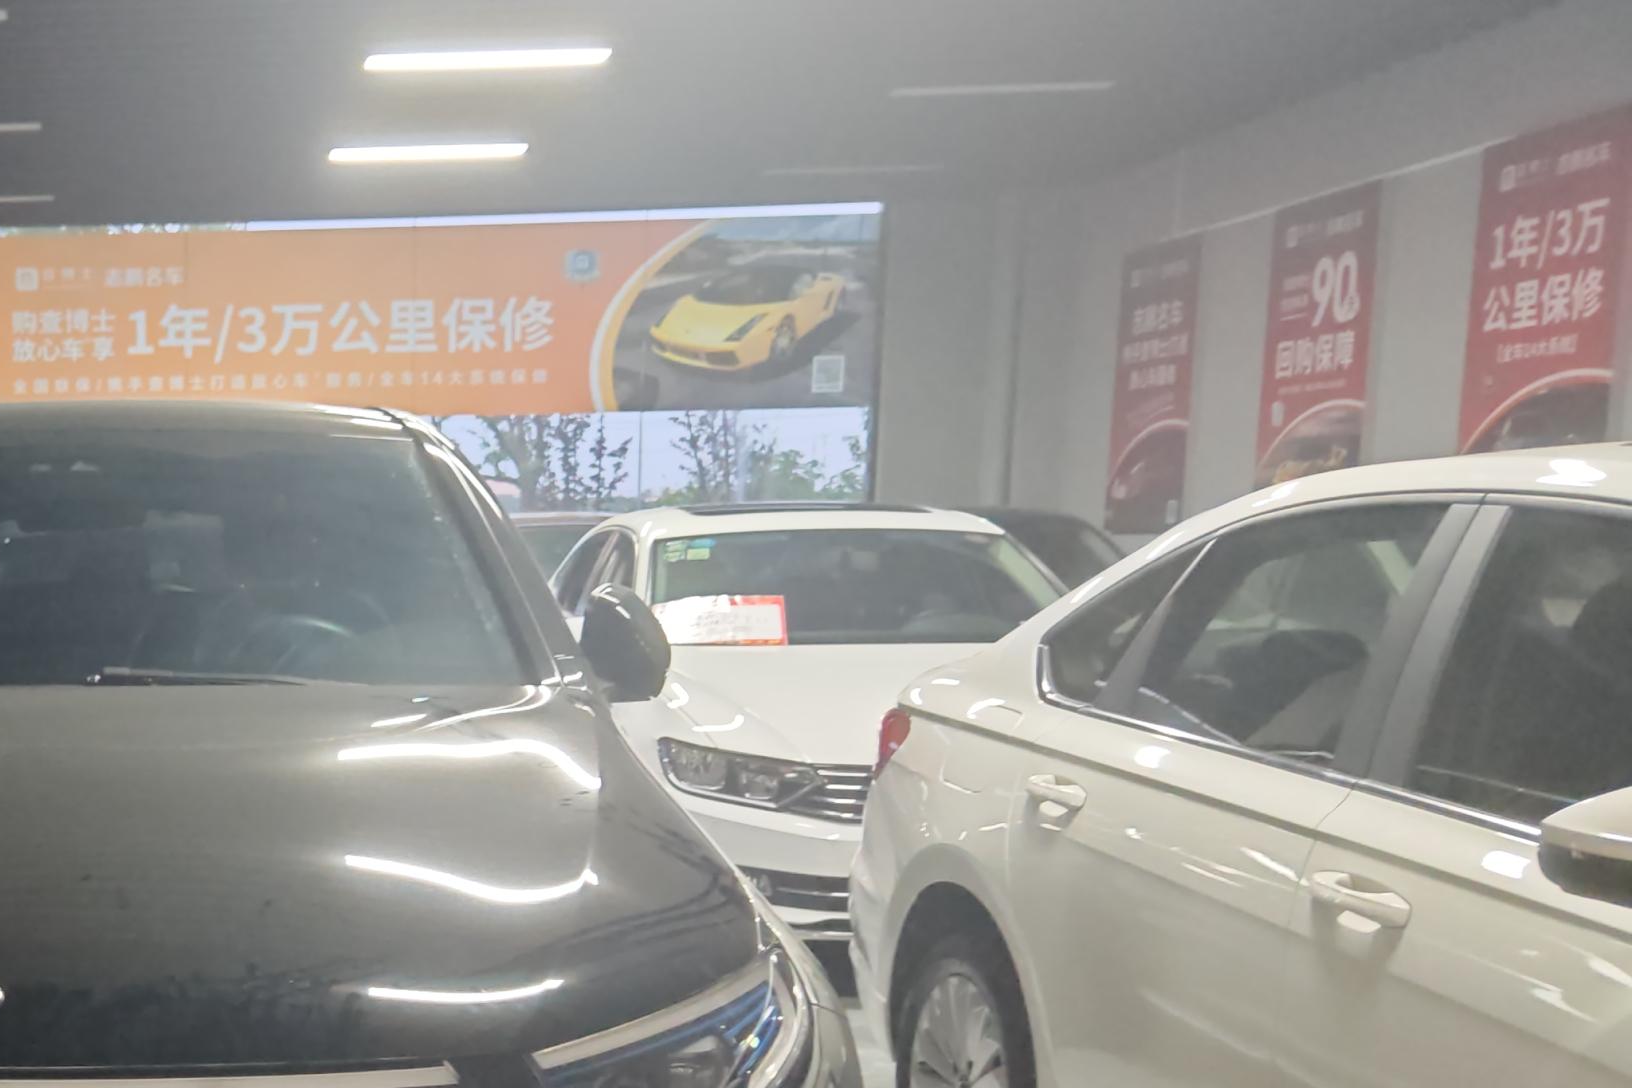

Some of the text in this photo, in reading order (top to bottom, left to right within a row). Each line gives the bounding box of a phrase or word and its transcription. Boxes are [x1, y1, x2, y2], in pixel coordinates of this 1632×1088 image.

[1488, 198, 1611, 271] 1年/3万
[127, 296, 555, 365] 1年/3万公里保修
[1482, 267, 1605, 332] 公里保修
